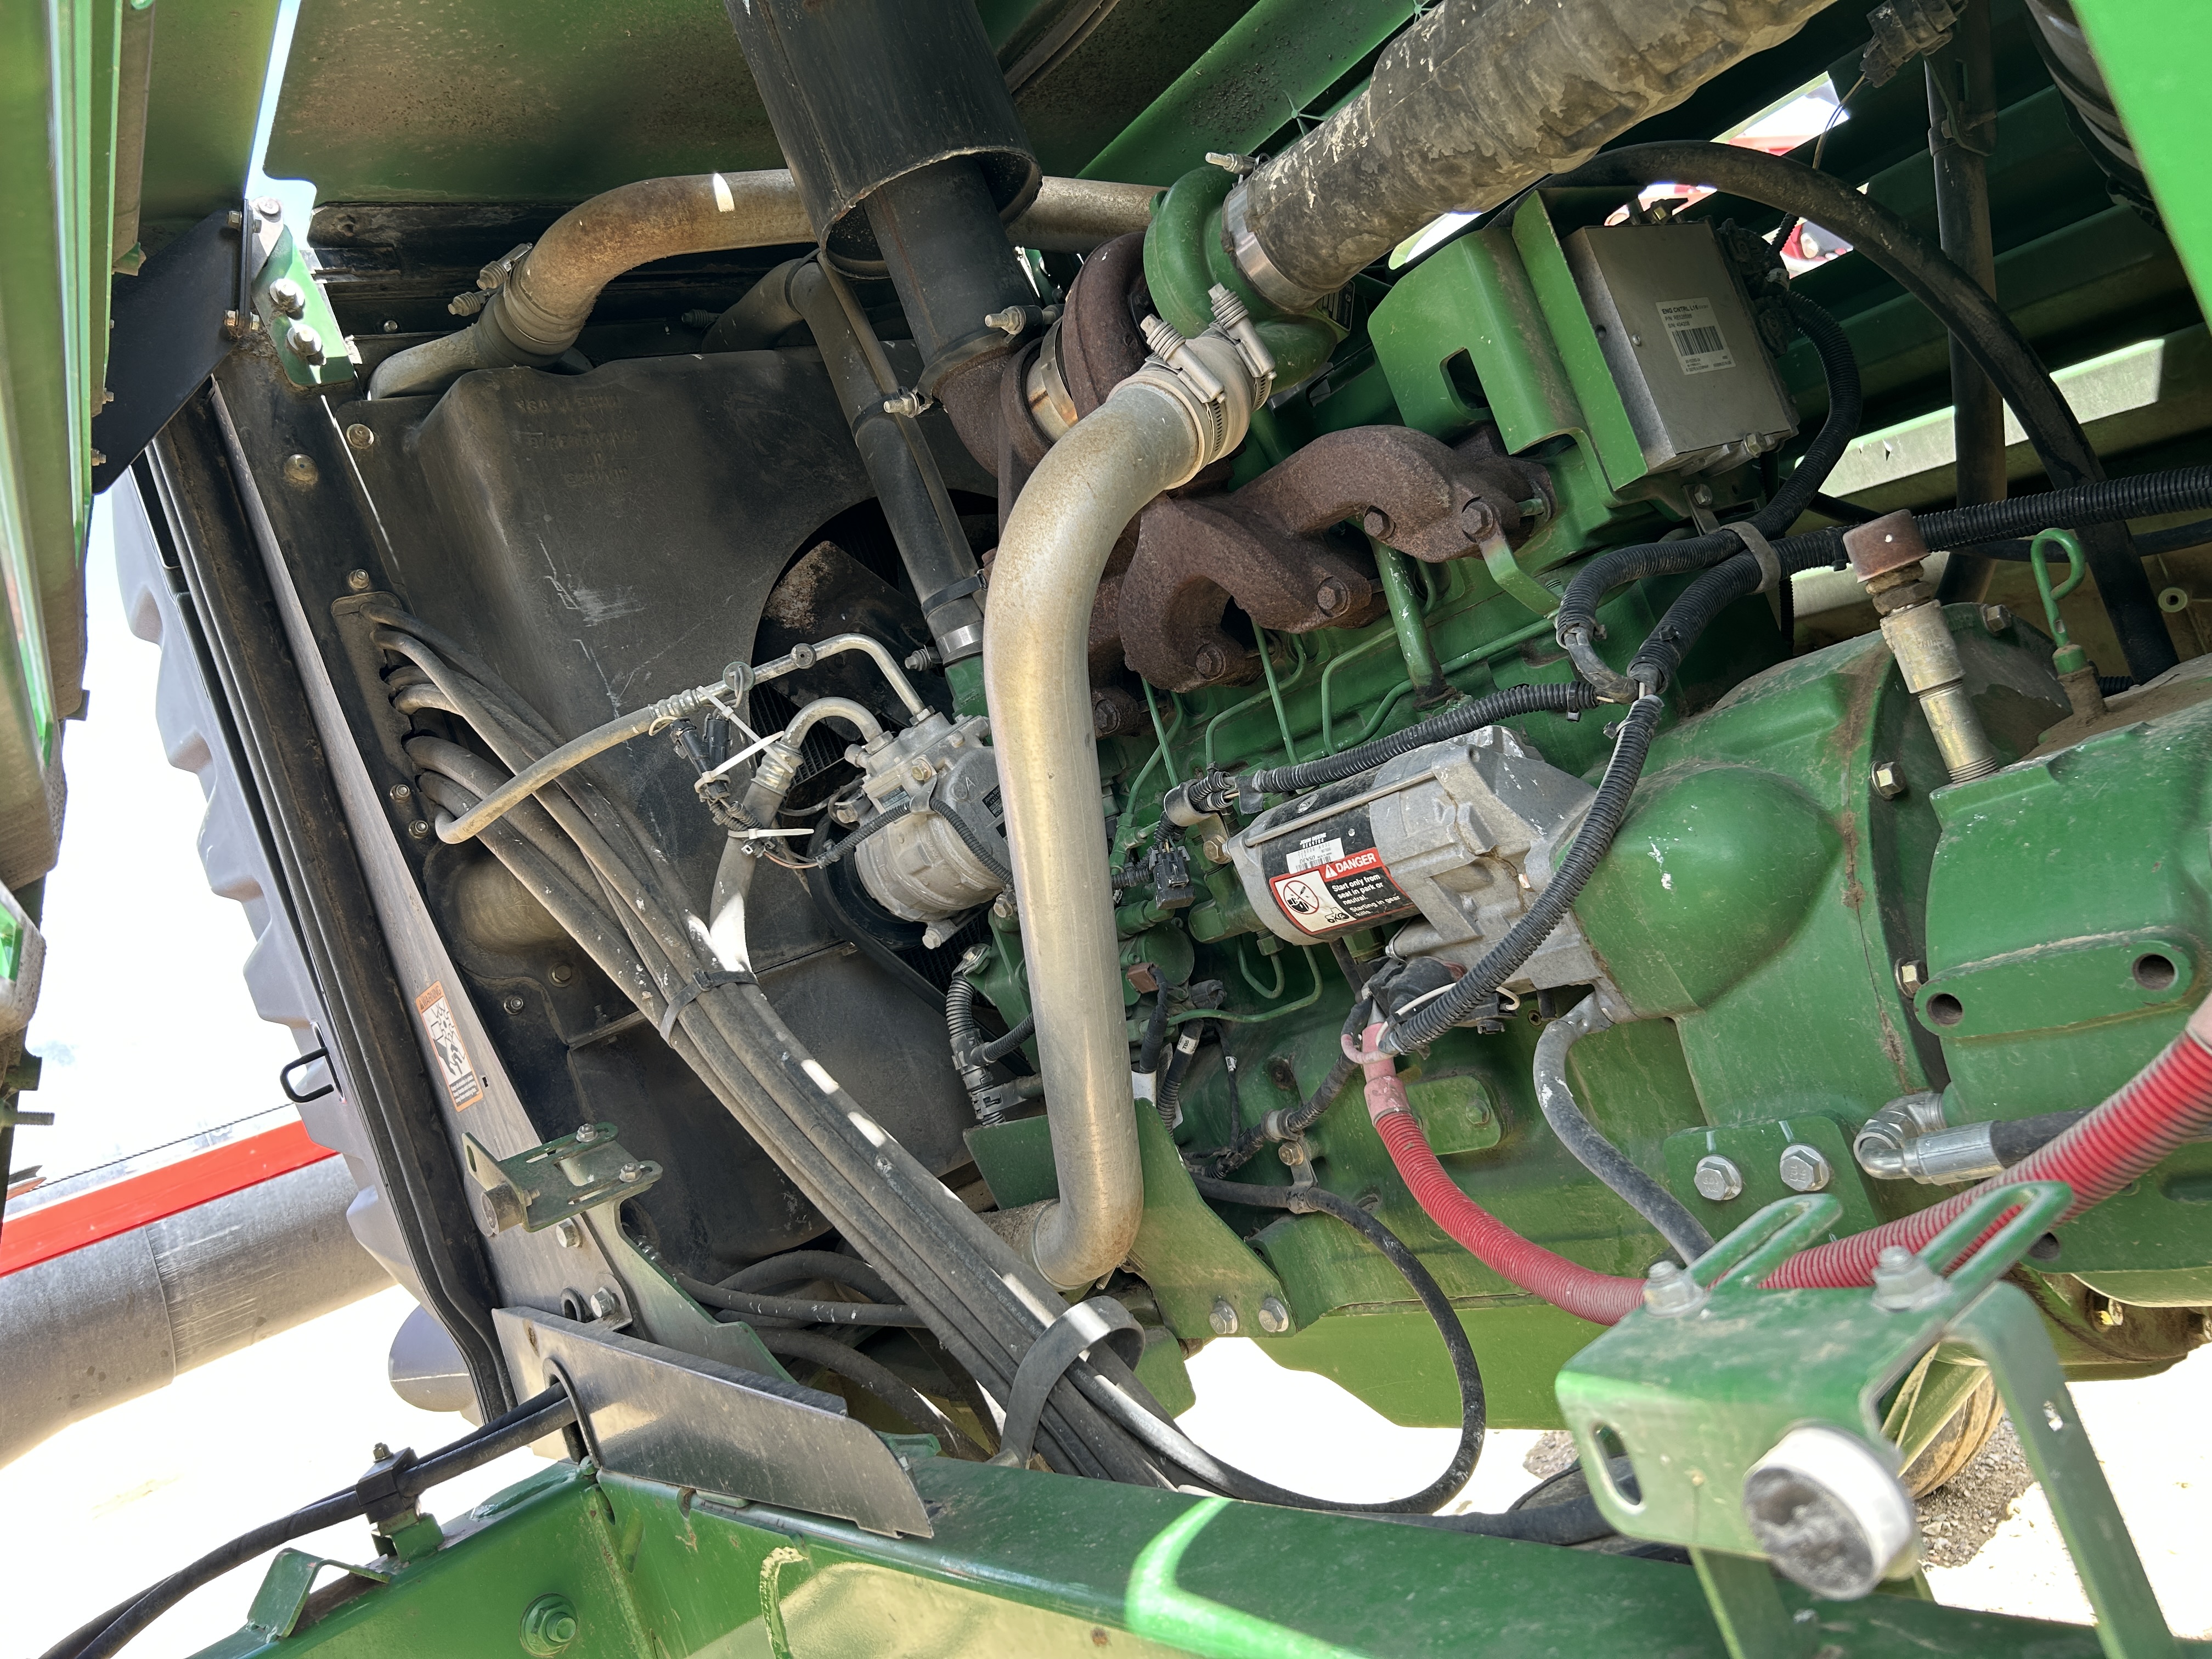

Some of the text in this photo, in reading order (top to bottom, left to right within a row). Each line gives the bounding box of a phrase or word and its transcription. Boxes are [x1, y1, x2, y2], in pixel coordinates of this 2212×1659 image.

[1299, 855, 1316, 864] DENSO
[1336, 853, 1376, 873] DANGER
[1331, 874, 1381, 892] Start only from
[1338, 890, 1352, 899] seat
[1360, 884, 1375, 895] park
[1342, 895, 1369, 905] neutral.
[1350, 902, 1375, 912] Starting
[1384, 895, 1401, 904] gear
[422, 985, 441, 1007] WARNING
[1006, 1301, 1015, 1312] FOR
[1075, 1368, 1090, 1382] MADE
[1090, 1380, 1098, 1389] IN
